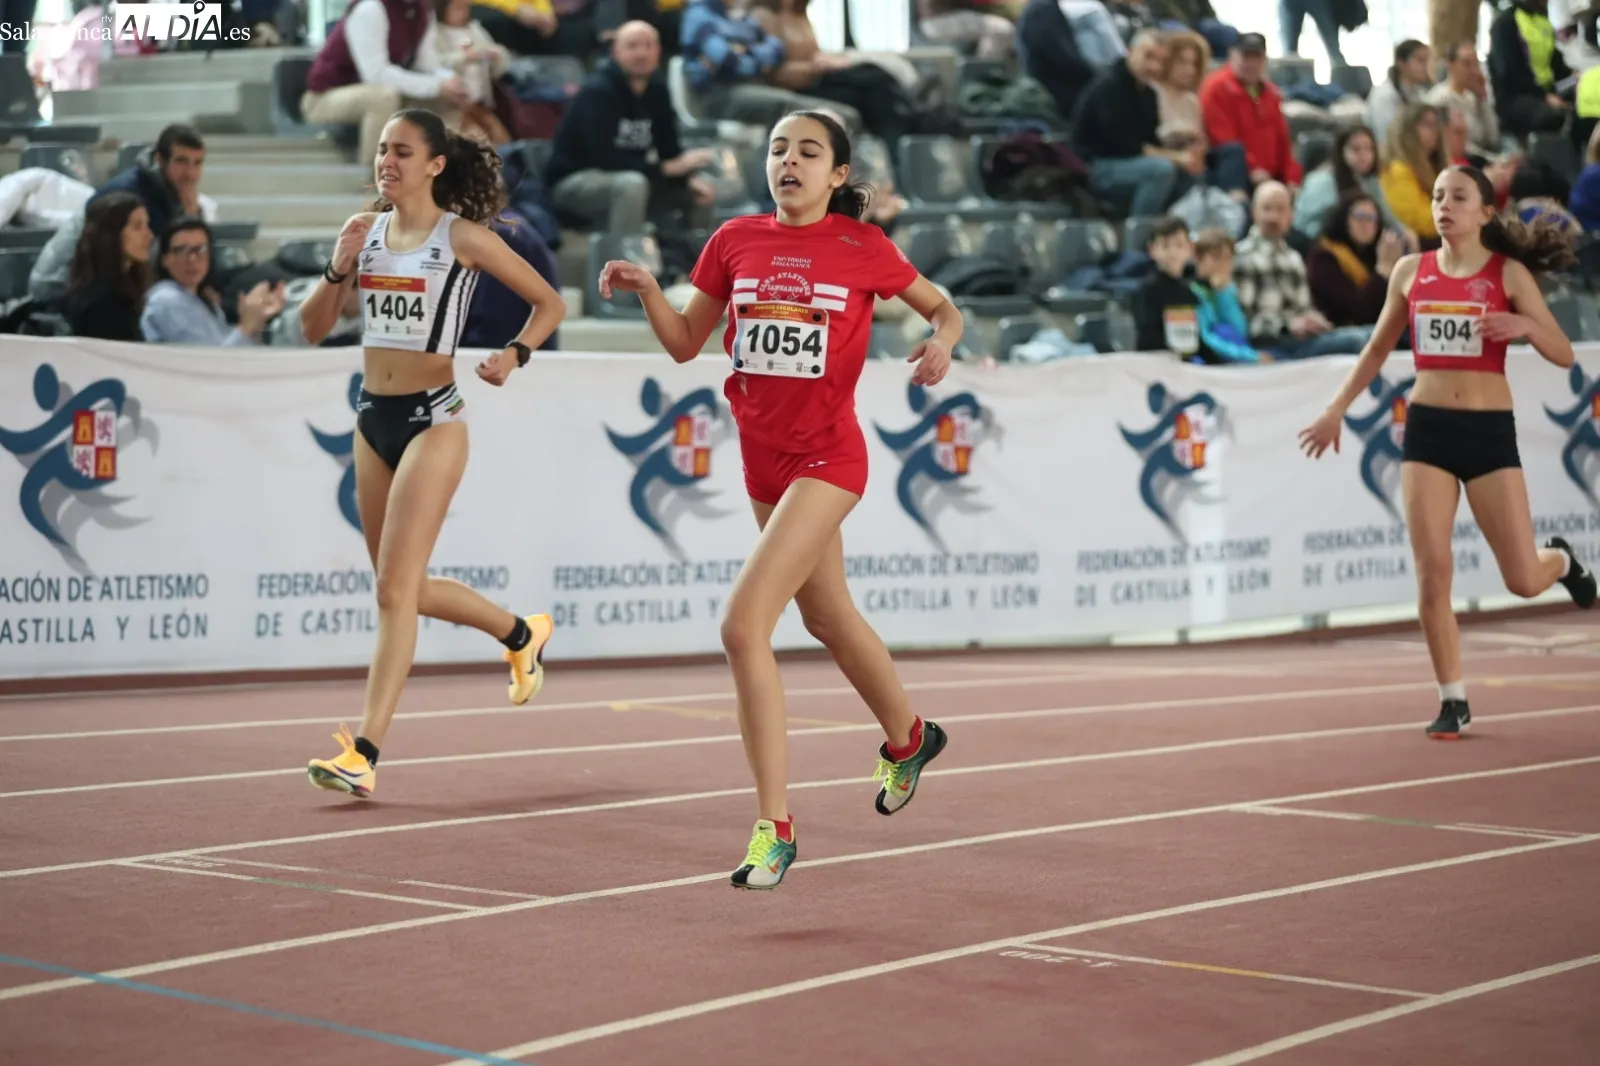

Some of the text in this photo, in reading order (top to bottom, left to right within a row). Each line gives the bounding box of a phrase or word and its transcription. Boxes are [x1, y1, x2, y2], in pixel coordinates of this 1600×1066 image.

[367, 293, 424, 322] 1404
[746, 323, 822, 358] 1054
[1429, 318, 1471, 341] 504
[1532, 512, 1586, 534] ERACIÓN
[553, 560, 662, 591] FEDERACIÓN
[844, 552, 926, 578] DERACIÓN
[67, 575, 94, 603] DE
[100, 573, 209, 601] ATLETISMO
[257, 565, 373, 599] FEDERACIÓN
[864, 582, 1040, 613] CASTILLA Y LEÓN
[1111, 578, 1192, 606] CASTILLA
[1228, 567, 1271, 595] LEÓN
[116, 615, 130, 641] Y
[148, 606, 208, 641] LEÓN
[254, 607, 376, 638] DE CASTIL
[553, 595, 721, 627] DE CASTILLA Y
